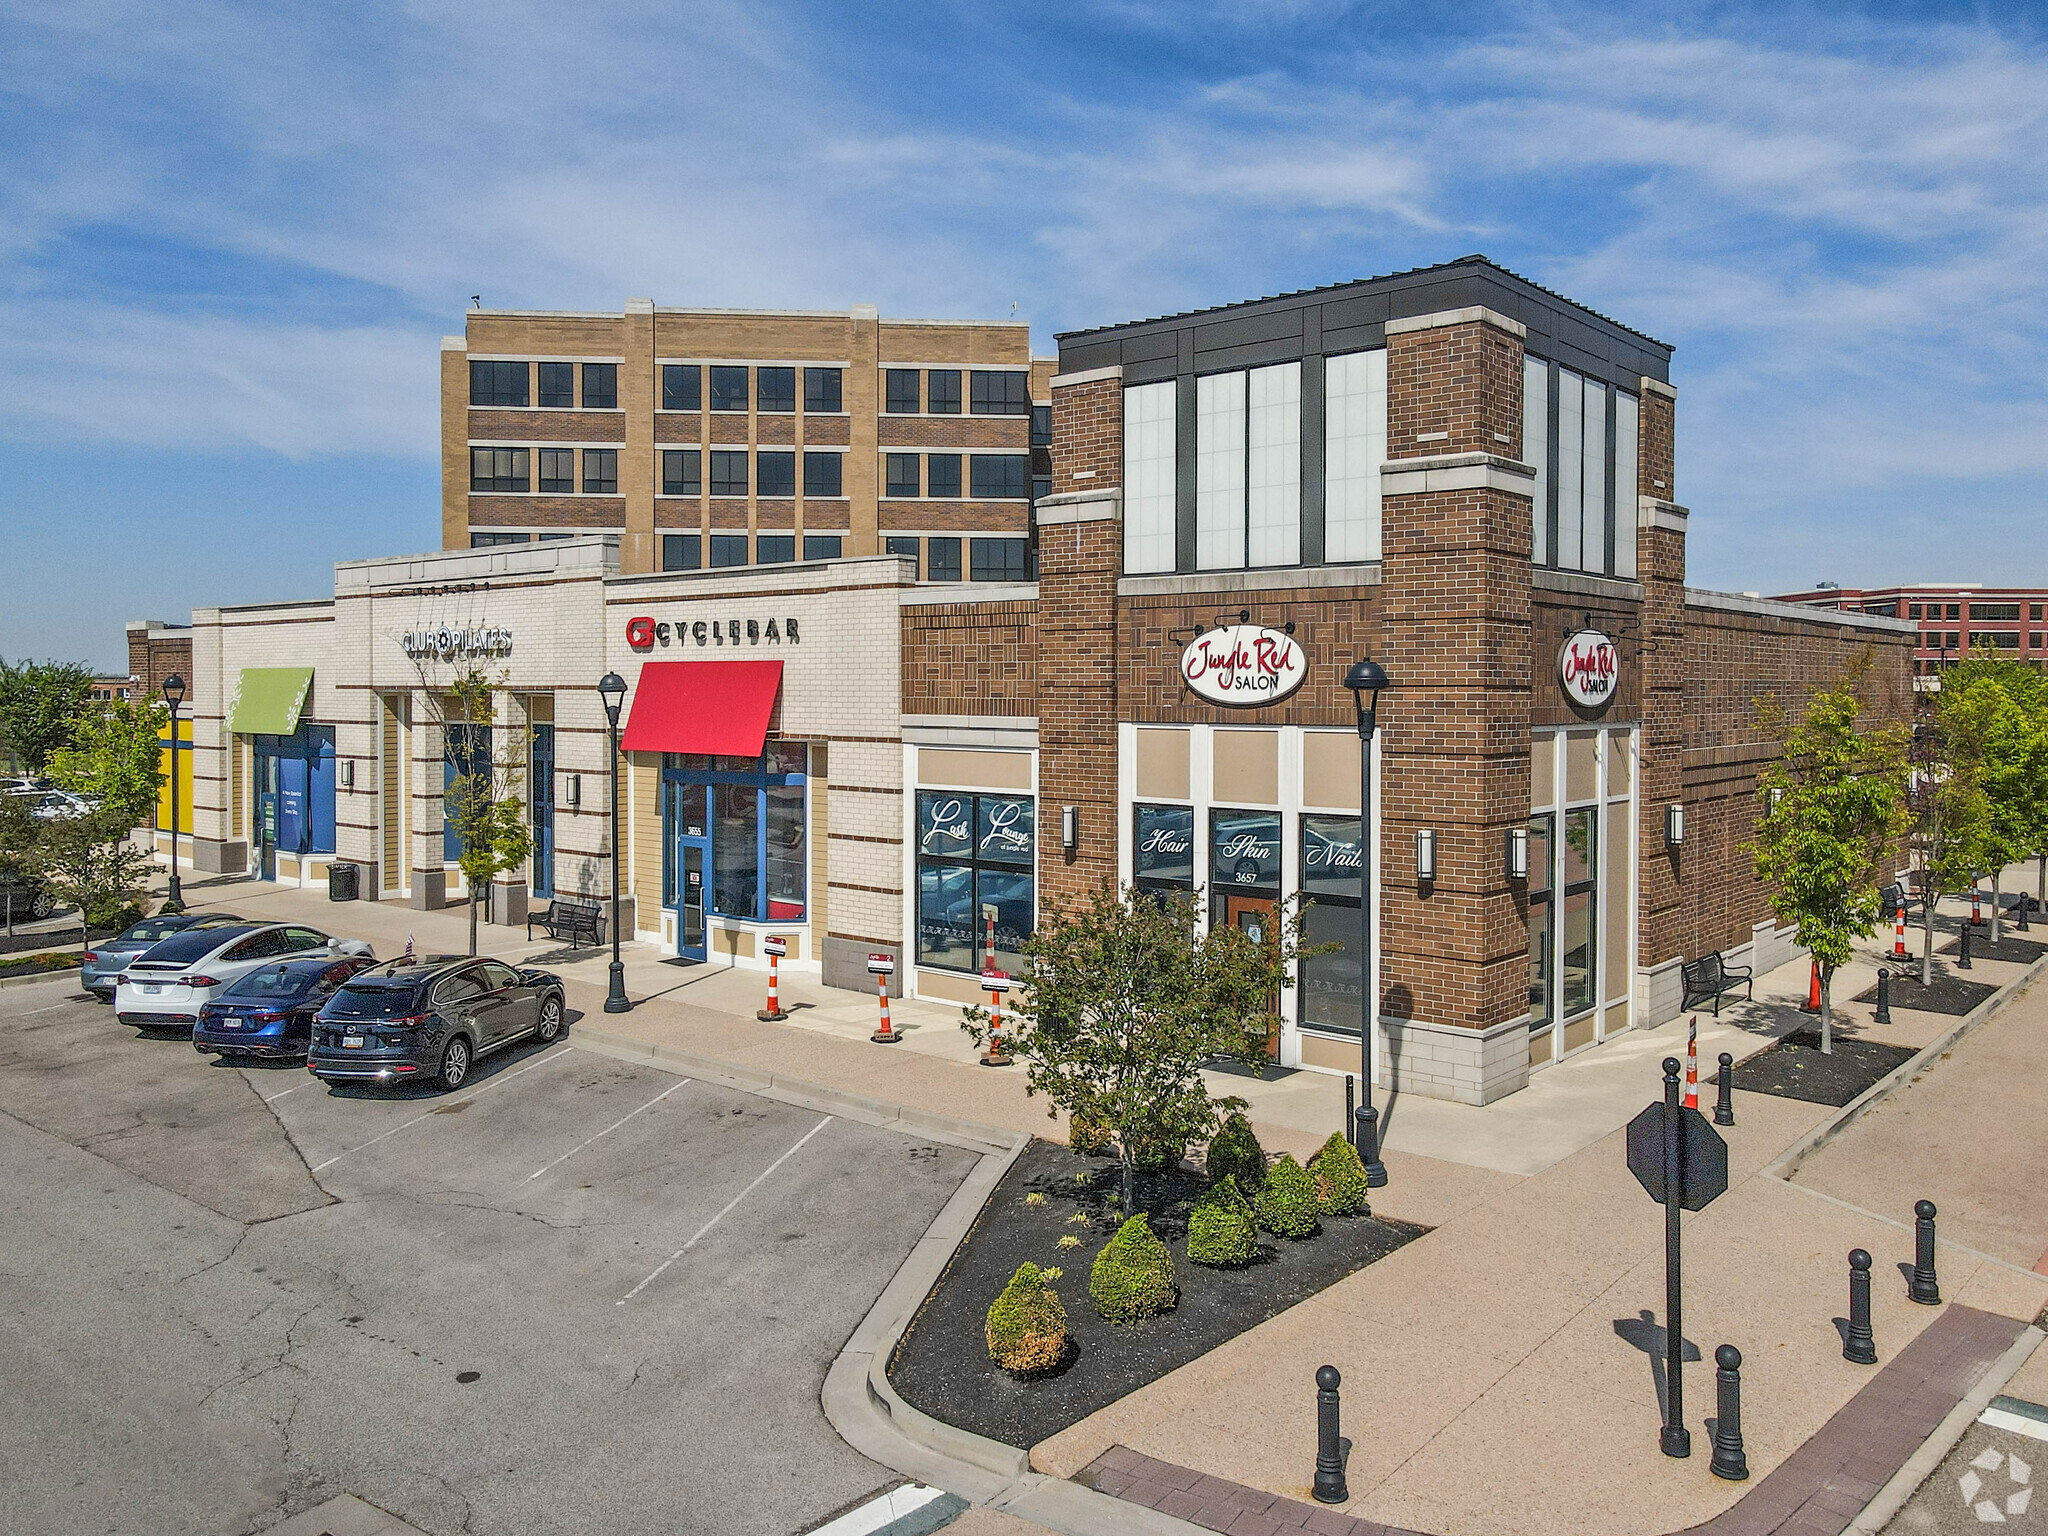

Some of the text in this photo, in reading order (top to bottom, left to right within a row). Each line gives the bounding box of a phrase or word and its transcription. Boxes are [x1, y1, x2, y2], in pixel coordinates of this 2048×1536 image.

[402, 628, 512, 652] CLUB PILATES
[656, 618, 798, 643] CYCLEBAR
[1187, 637, 1295, 690] Jungle Red
[1565, 643, 1597, 692] Jungle
[1235, 675, 1279, 690] SALON
[687, 826, 702, 836] 3655
[922, 800, 1030, 850] Lash Lounge
[1140, 829, 1189, 853] Hair
[1222, 834, 1271, 860] Skin
[1235, 871, 1258, 884] 3657
